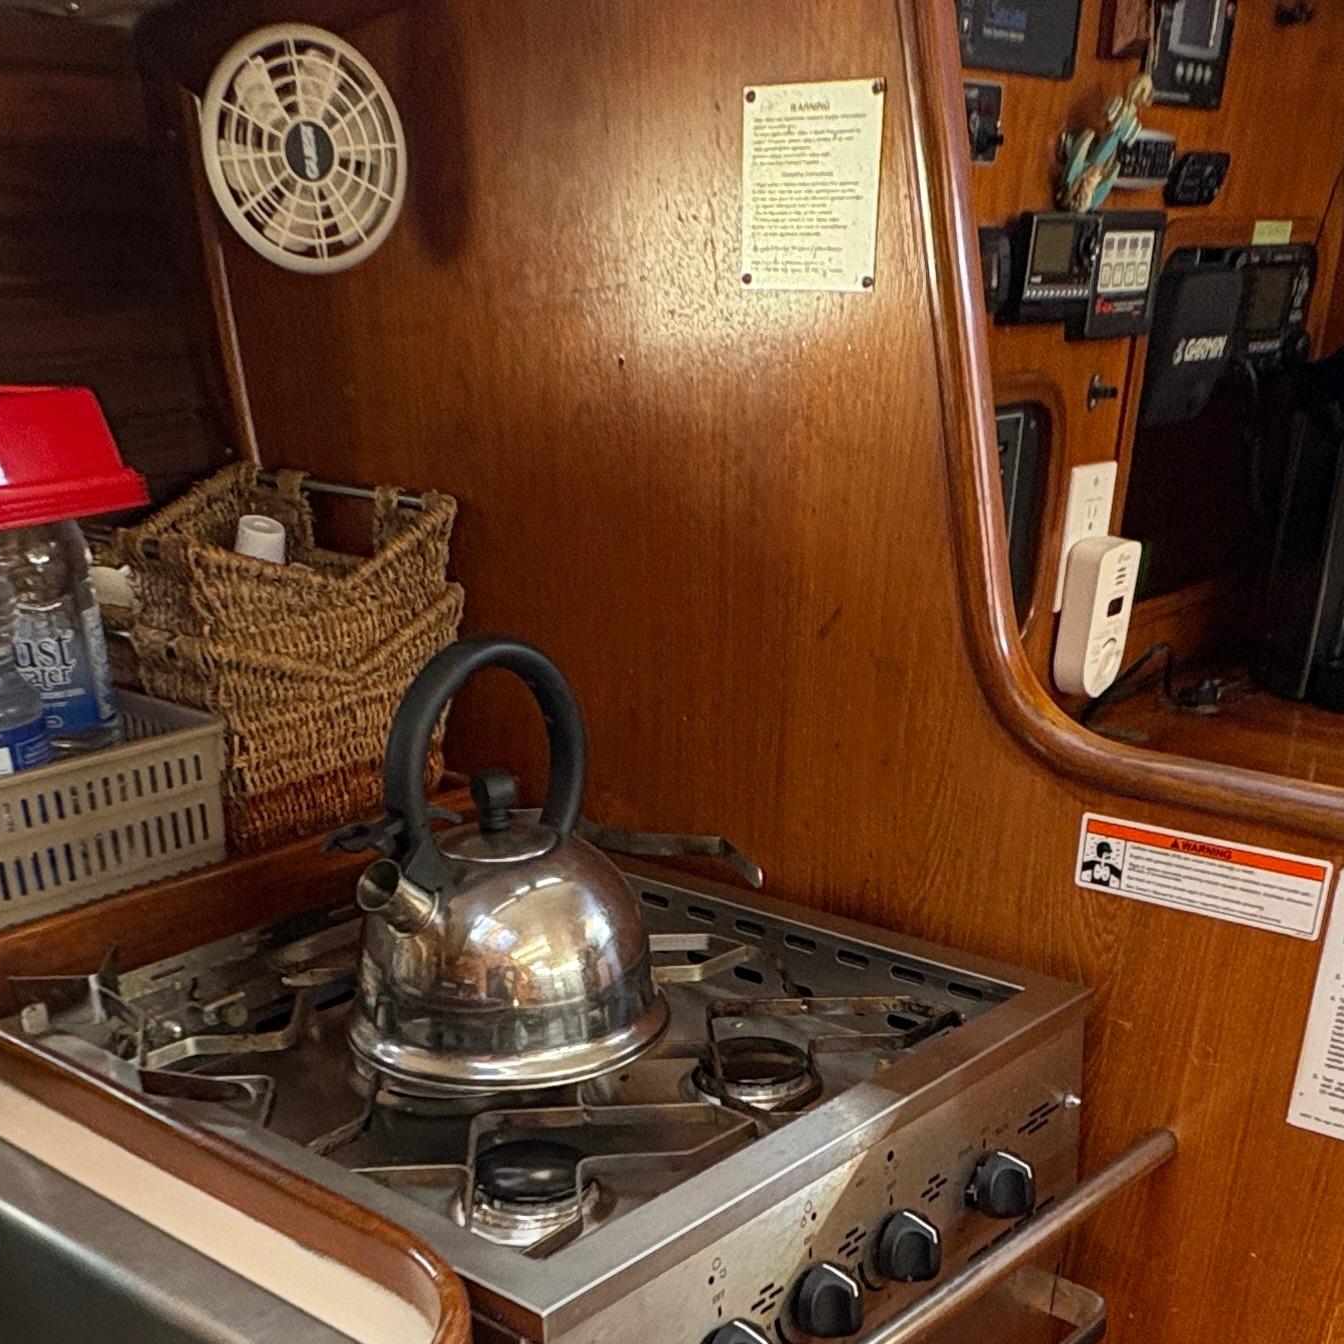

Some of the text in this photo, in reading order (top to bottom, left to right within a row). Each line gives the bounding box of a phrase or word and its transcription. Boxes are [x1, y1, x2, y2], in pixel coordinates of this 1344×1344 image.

[1183, 334, 1227, 362] GARMIN
[16, 636, 75, 667] ust
[1182, 841, 1232, 860] WARNING
